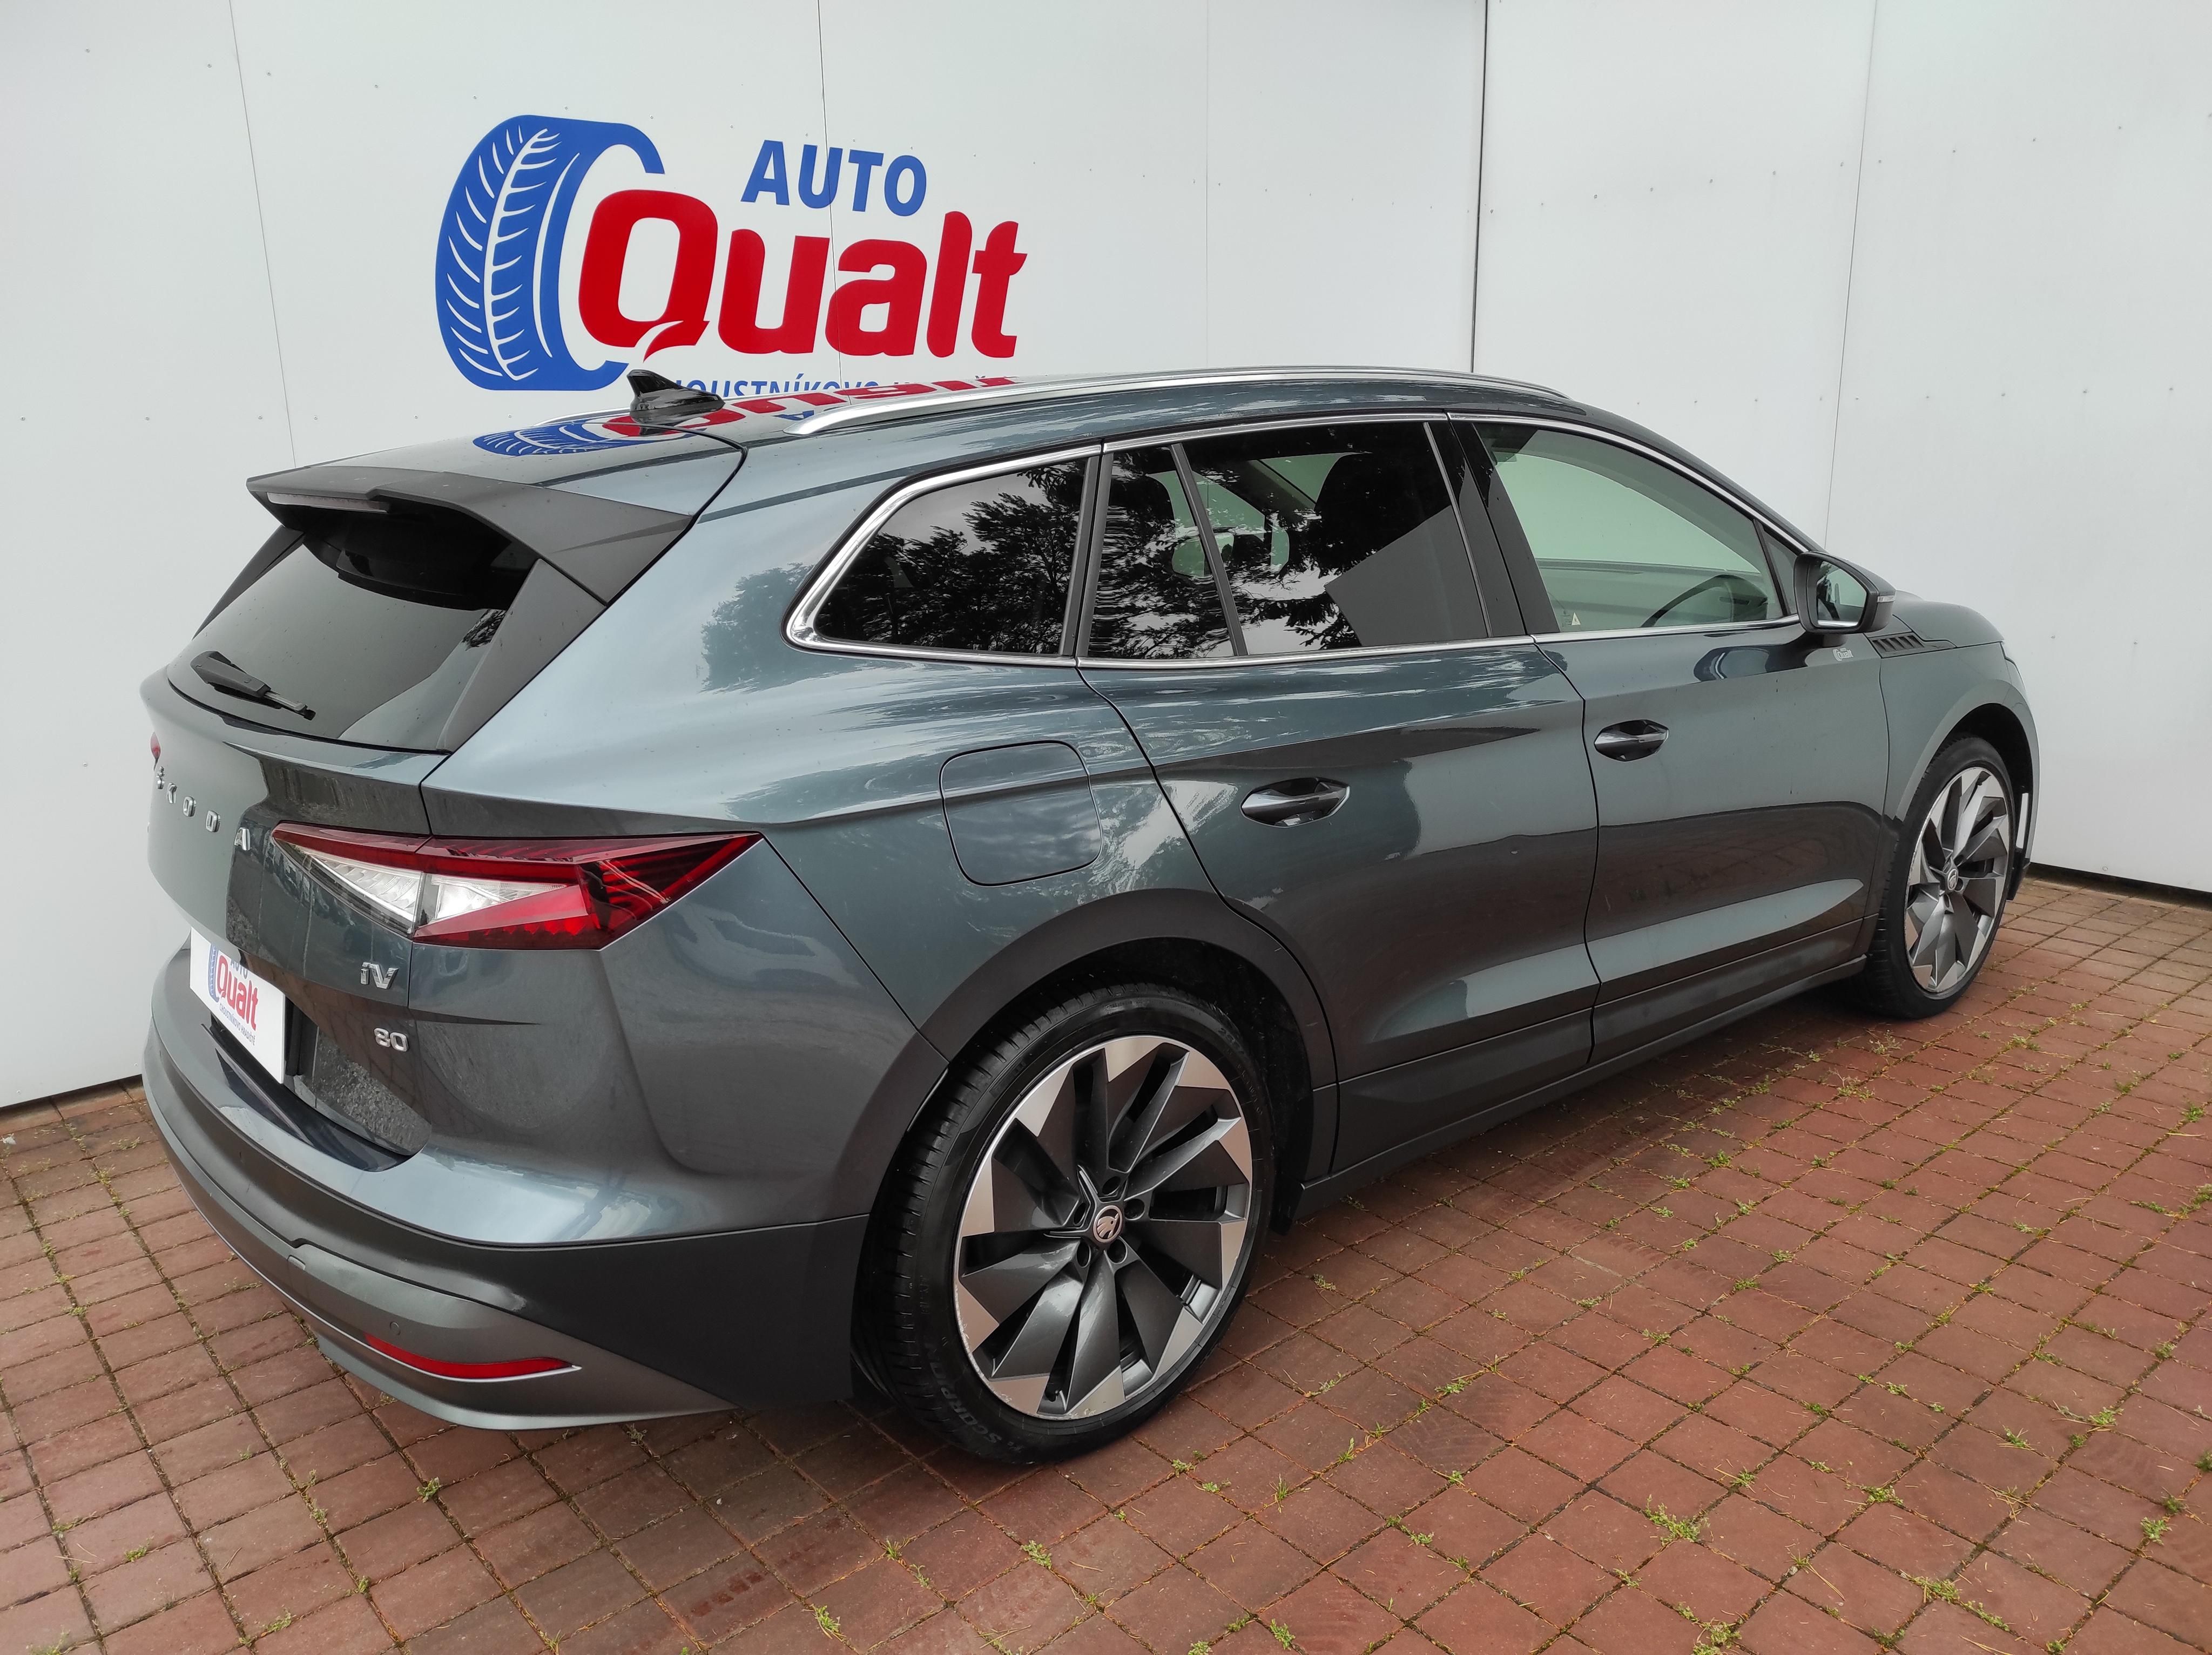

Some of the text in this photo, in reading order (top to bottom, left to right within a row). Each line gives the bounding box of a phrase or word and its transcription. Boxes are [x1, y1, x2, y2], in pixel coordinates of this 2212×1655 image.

[741, 139, 927, 217] AUTO
[578, 189, 1028, 363] Qualt
[217, 955, 259, 1031] Qualt
[360, 962, 400, 989] iV
[374, 1028, 409, 1052] 80
